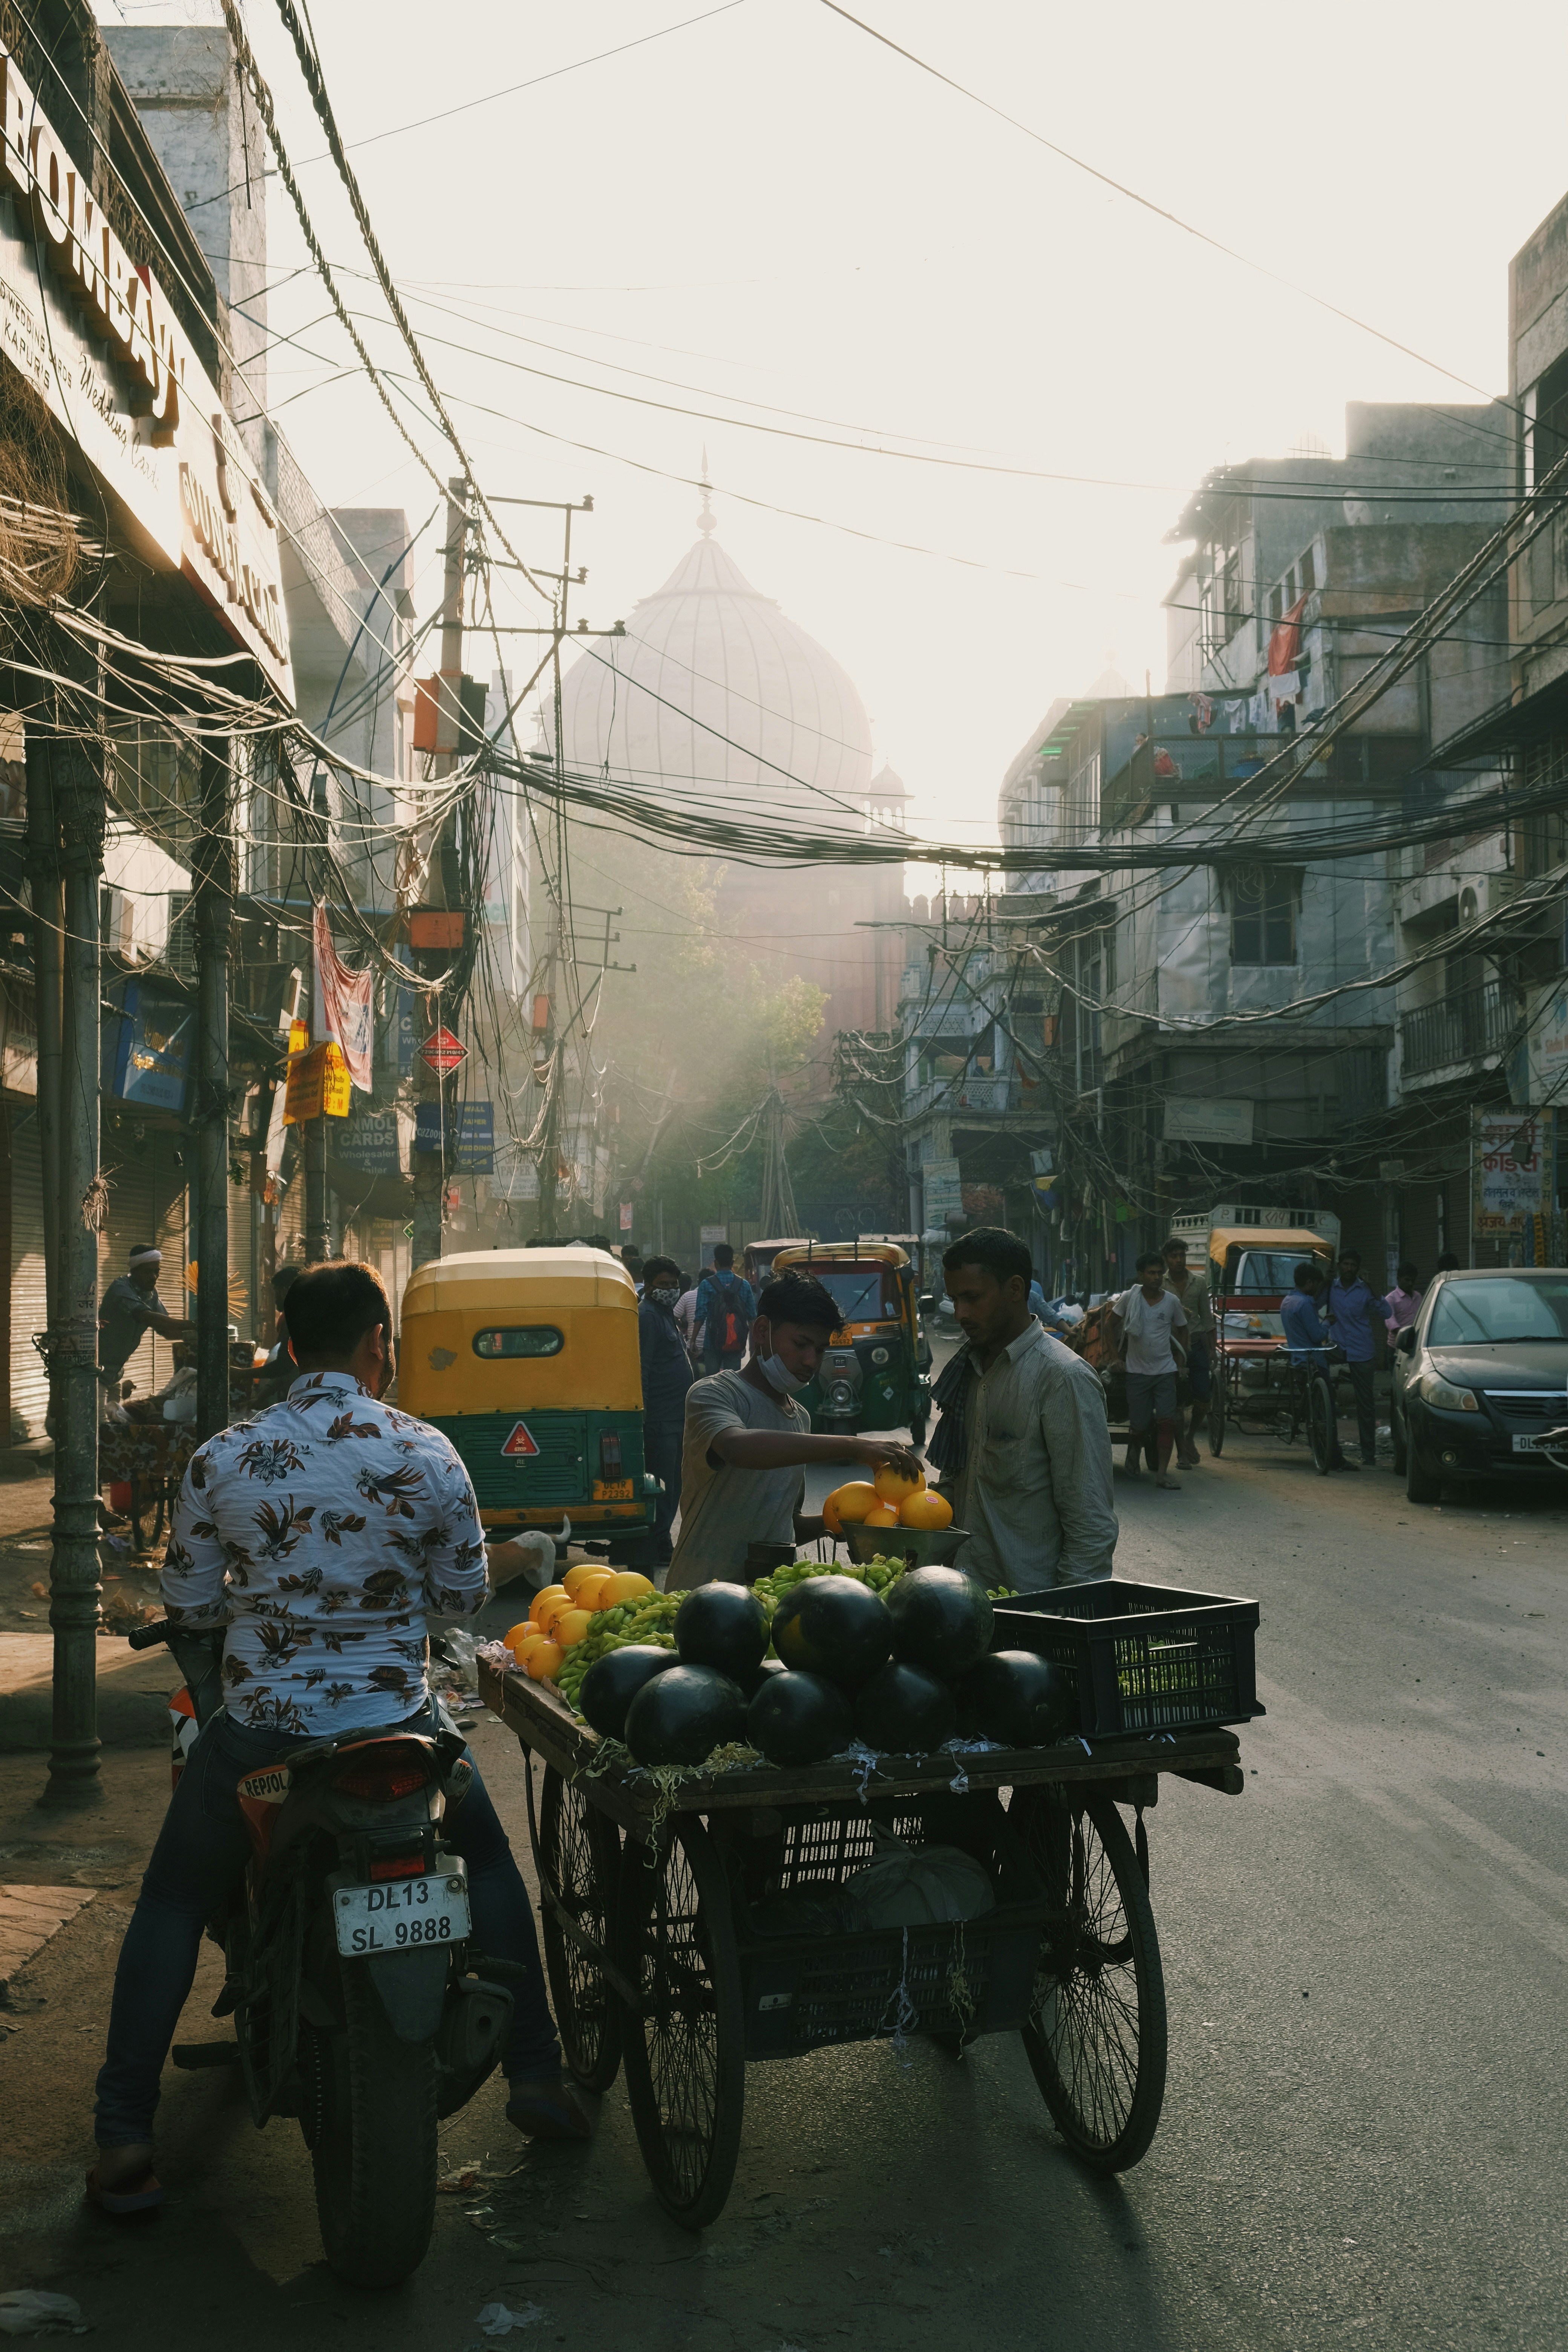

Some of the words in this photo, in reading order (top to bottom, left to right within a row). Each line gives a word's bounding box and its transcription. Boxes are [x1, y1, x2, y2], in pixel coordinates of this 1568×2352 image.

[10, 297, 45, 352] WEDDING
[5, 317, 50, 390] KAPUR'S
[79, 352, 127, 457] Wedding
[337, 1118, 395, 1131] ANMOL
[340, 1132, 395, 1146] CARDS
[339, 1150, 395, 1159] Wholesaler
[602, 1489, 631, 1499] P2392
[245, 1772, 287, 1797] REPSOL
[368, 1882, 429, 1912] DL13
[351, 1926, 383, 1952] SL
[395, 1916, 451, 1945] 9888
